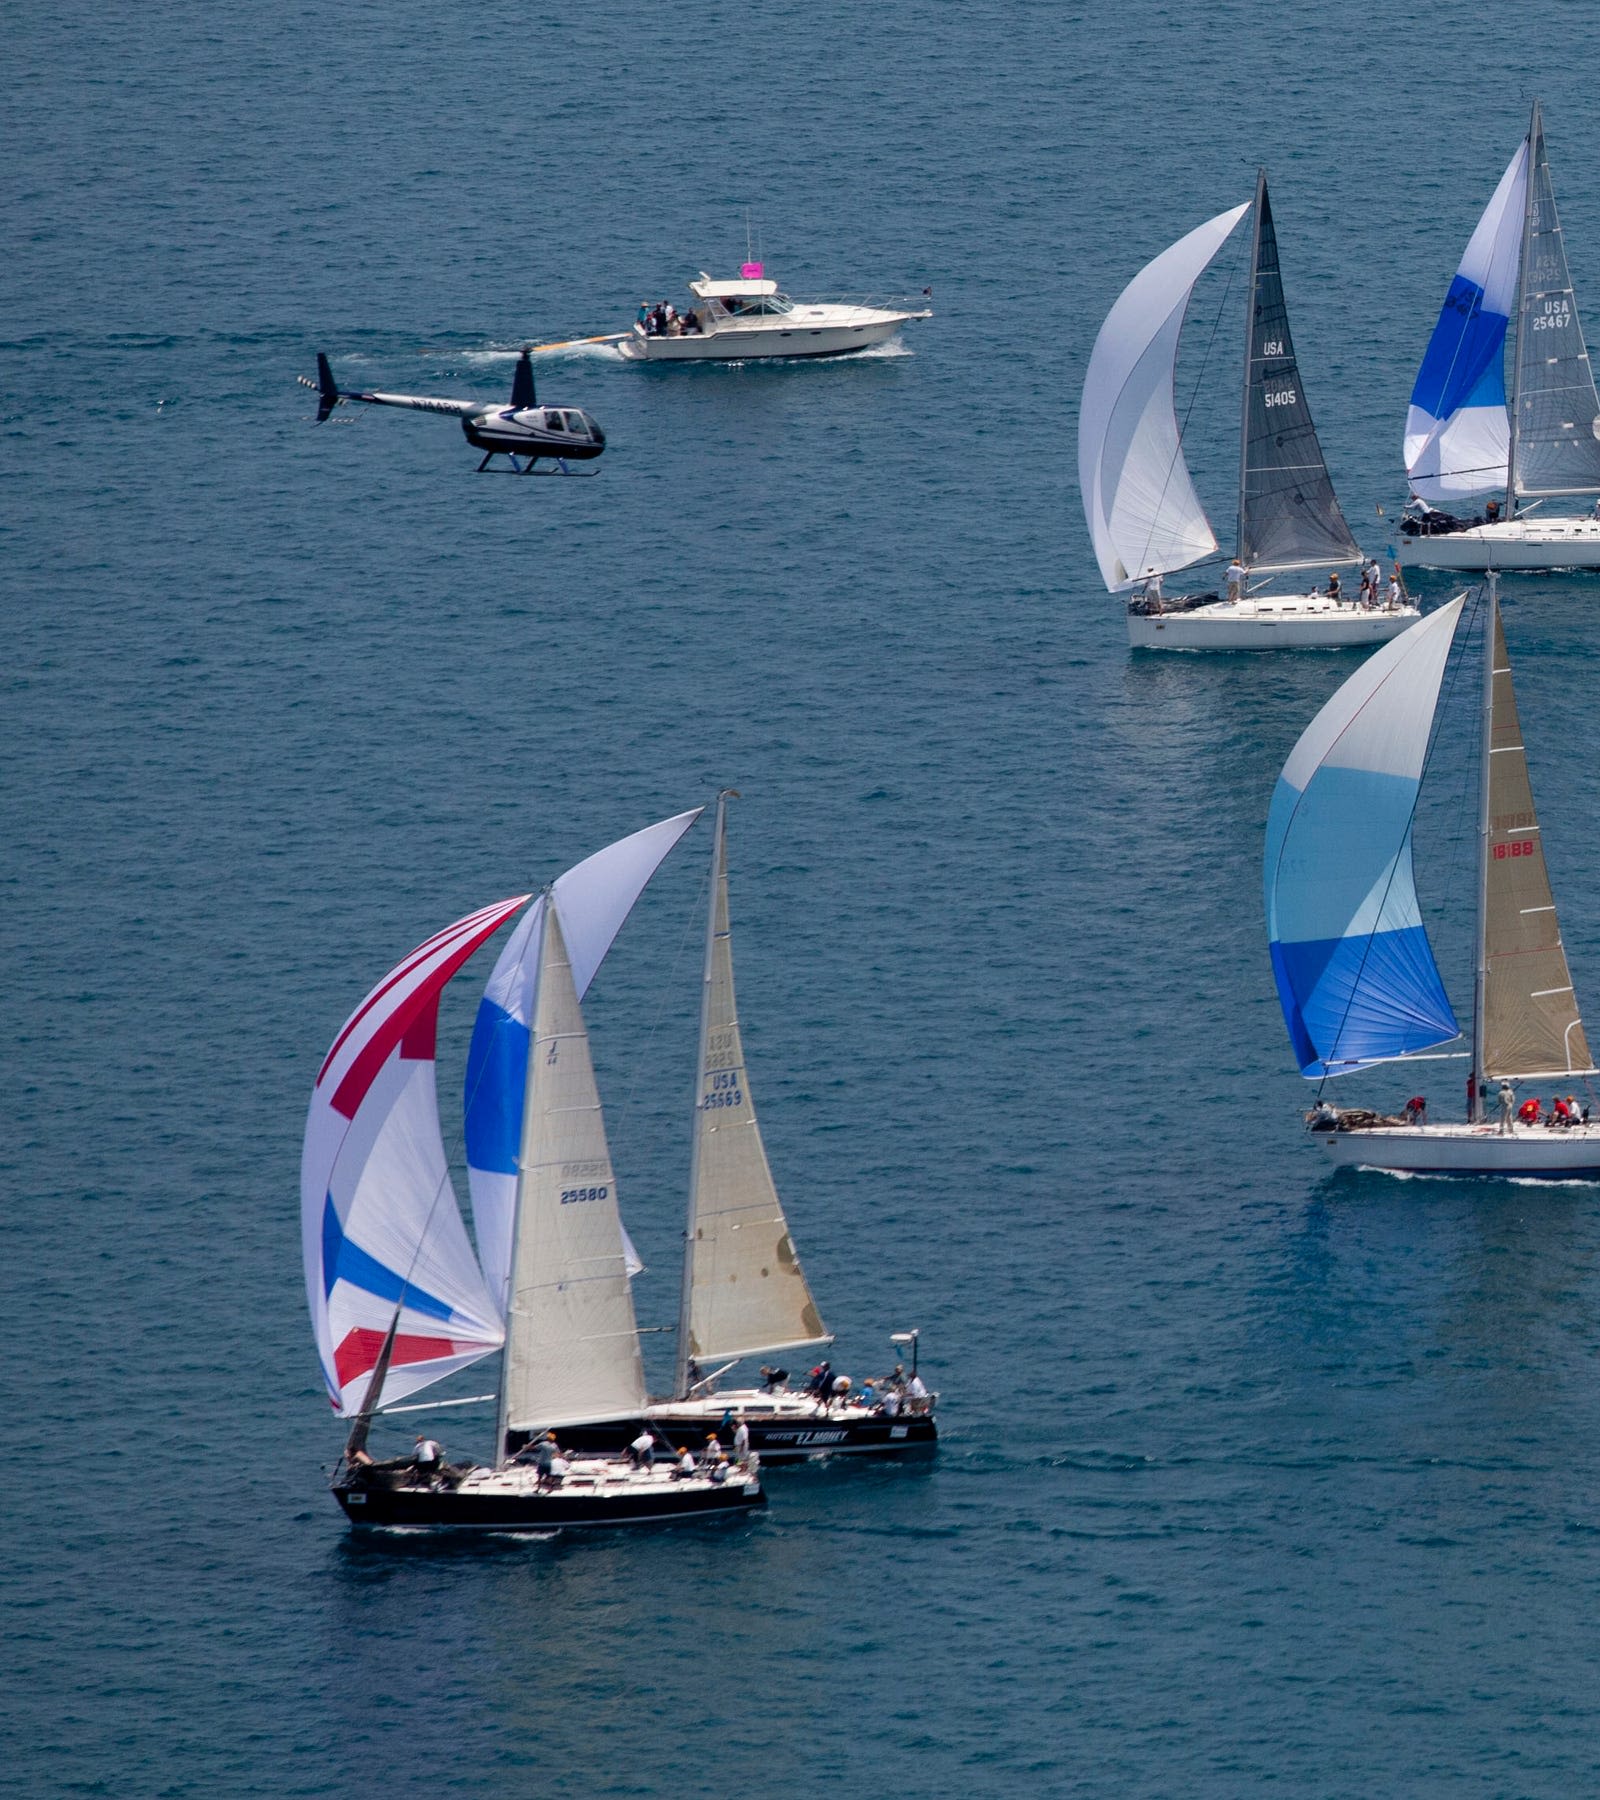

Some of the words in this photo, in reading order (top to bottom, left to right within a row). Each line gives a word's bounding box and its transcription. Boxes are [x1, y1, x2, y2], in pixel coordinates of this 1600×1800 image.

[1544, 300, 1569, 313] USA
[1533, 314, 1571, 331] 25467
[1263, 341, 1284, 355] USA
[1264, 390, 1297, 408] 51405
[713, 1072, 737, 1090] USA
[560, 1187, 608, 1204] 25580
